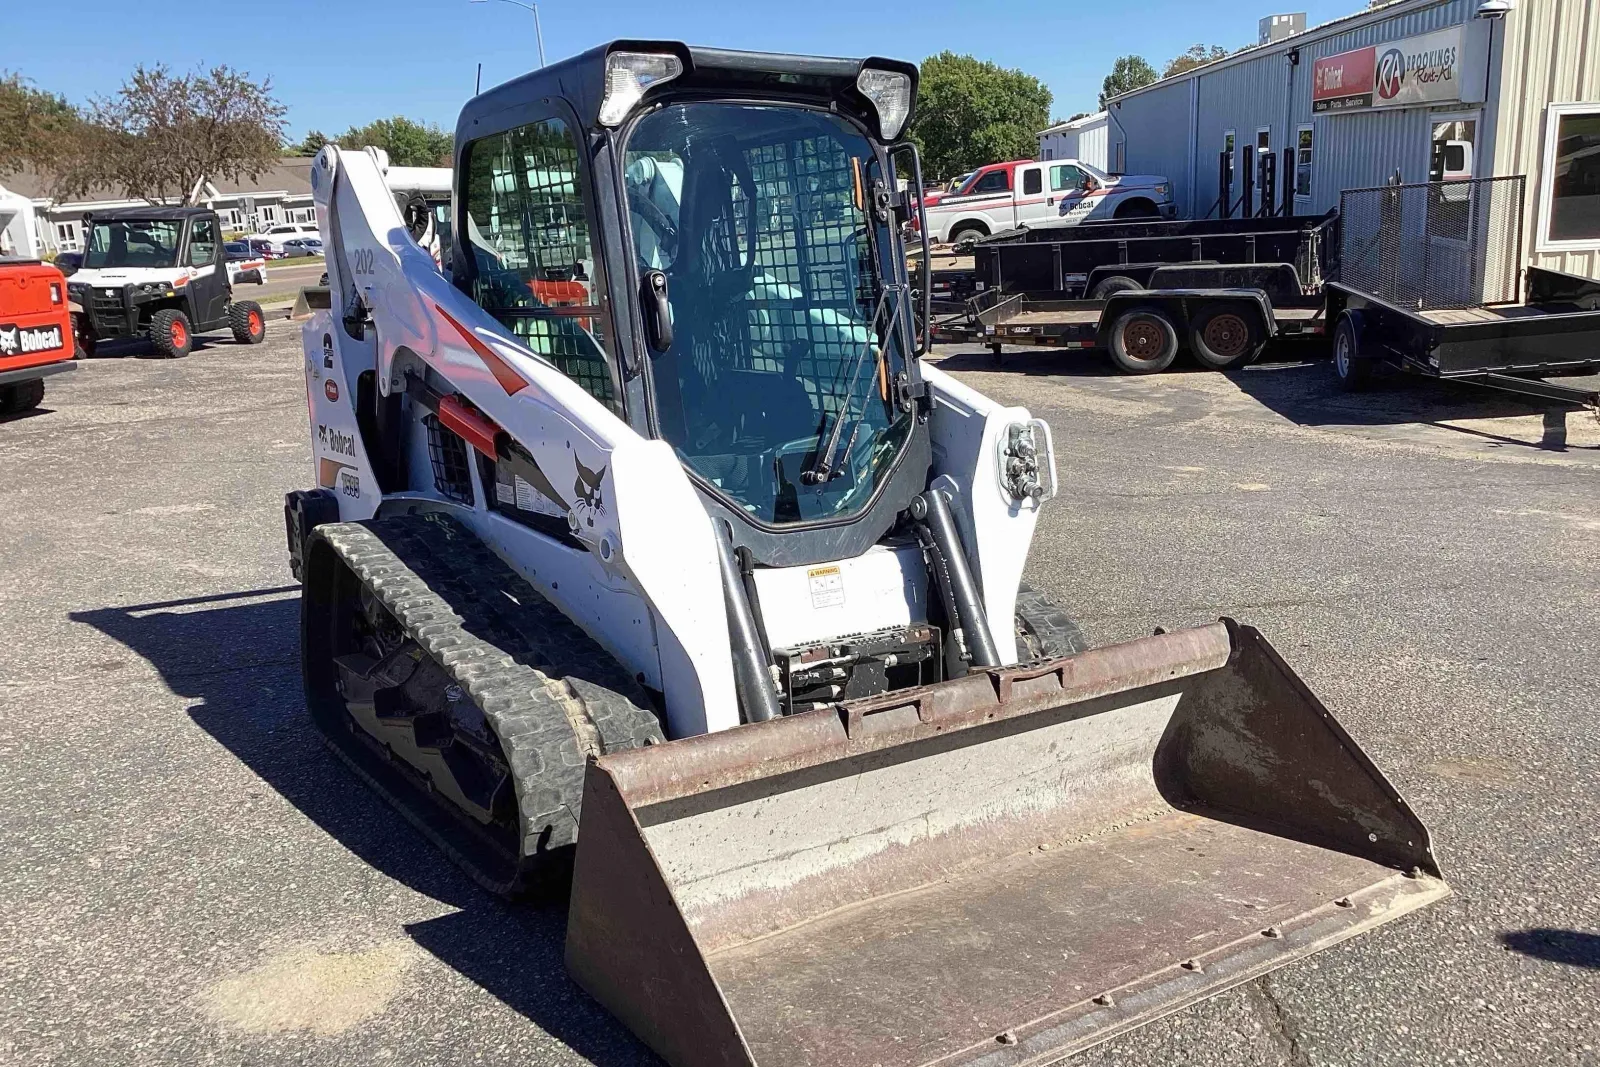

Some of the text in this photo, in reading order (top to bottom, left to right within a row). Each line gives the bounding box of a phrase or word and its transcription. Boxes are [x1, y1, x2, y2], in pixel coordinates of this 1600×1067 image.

[1407, 46, 1456, 72] BROOKINGS
[1324, 65, 1343, 91] Bobcat
[1413, 64, 1452, 85] Rent-All
[1345, 98, 1364, 107] Service
[1069, 200, 1094, 210] Bobcat
[354, 248, 375, 275] 202
[20, 327, 61, 352] Bobcat
[329, 428, 356, 458] Bobcat
[815, 567, 838, 576] WARNING
